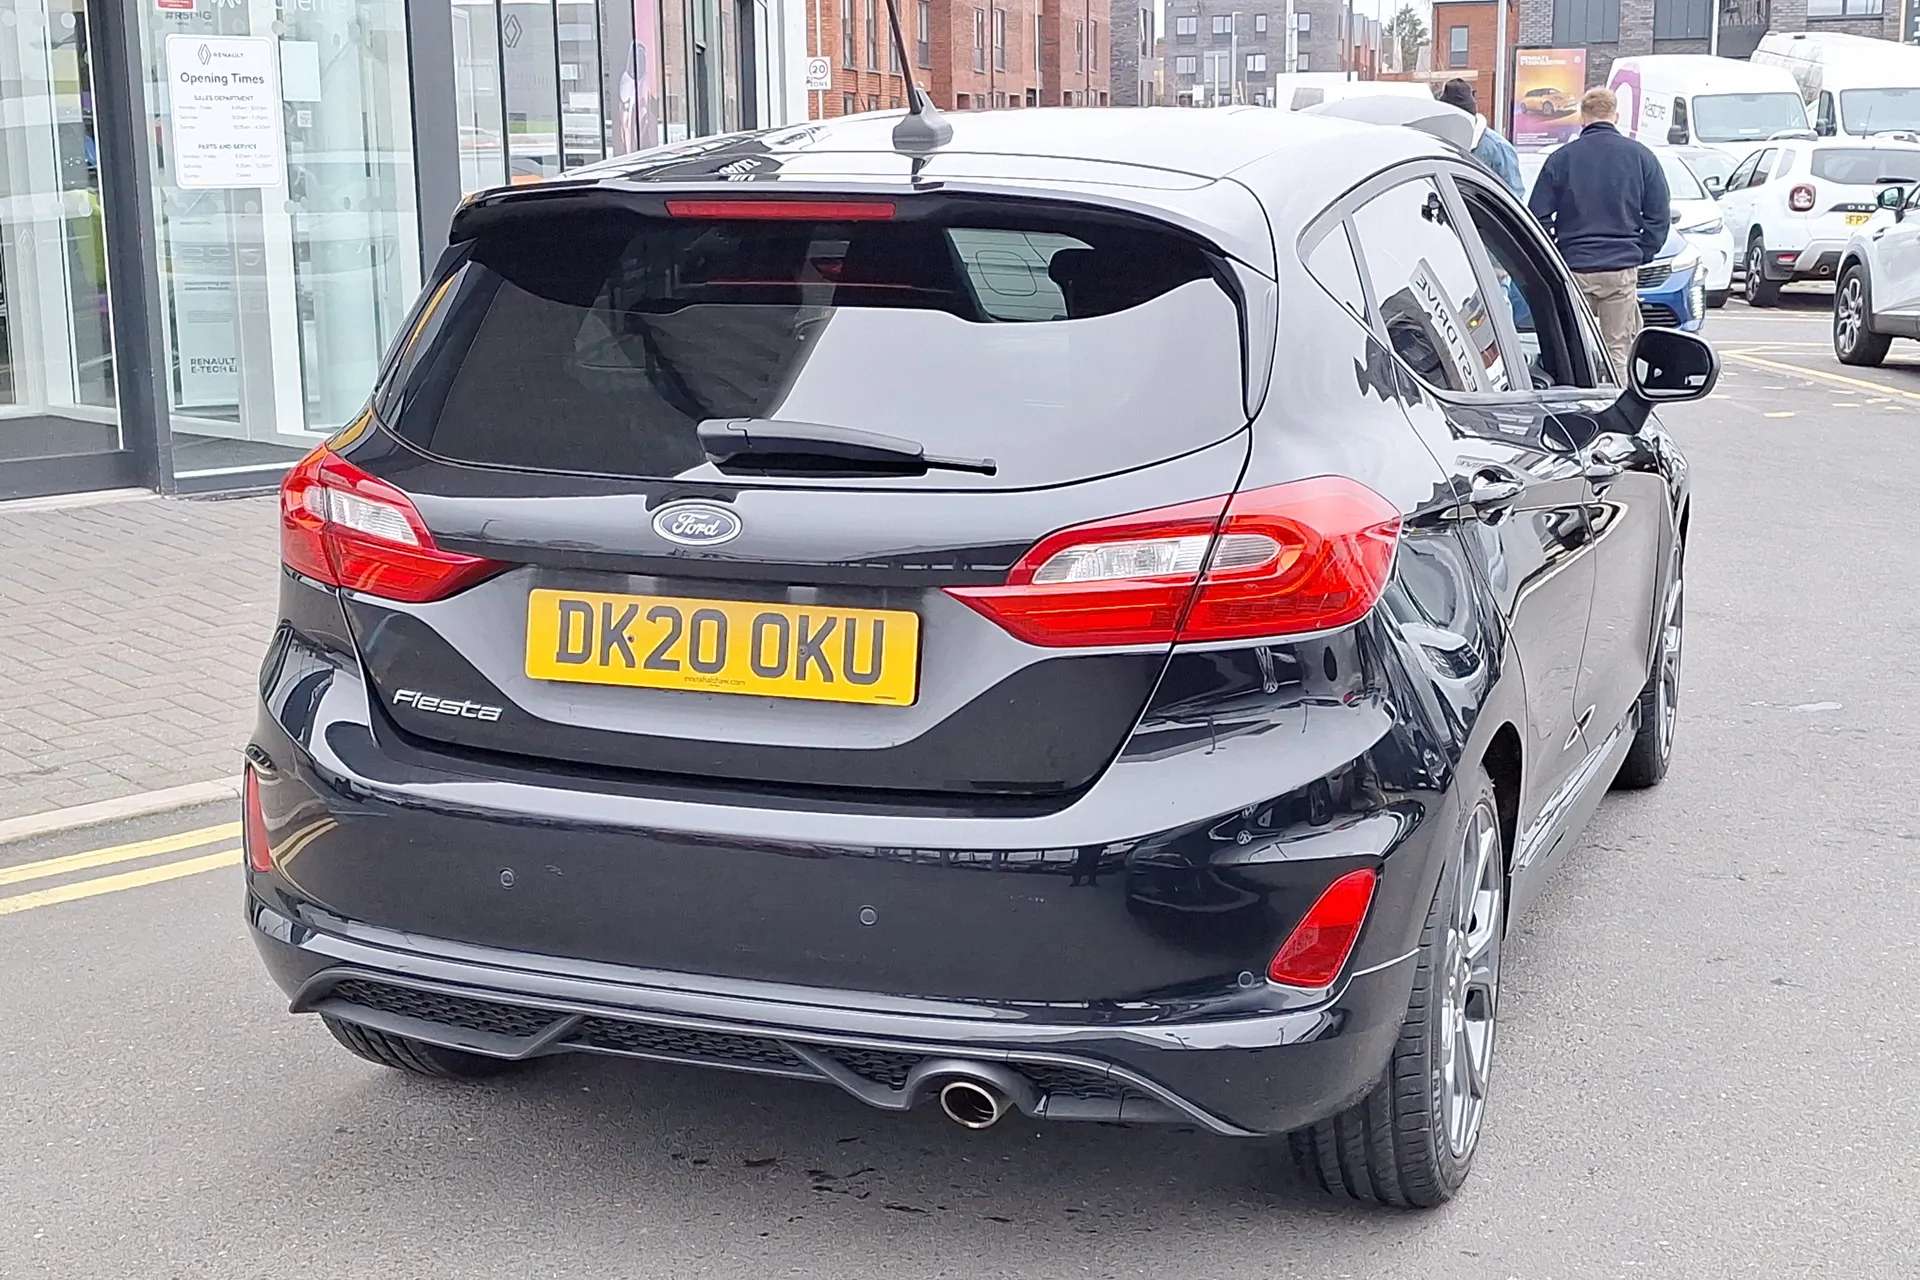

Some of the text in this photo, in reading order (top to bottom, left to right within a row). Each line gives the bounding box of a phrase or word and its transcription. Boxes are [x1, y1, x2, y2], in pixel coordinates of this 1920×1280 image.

[180, 72, 265, 86] Opening Times
[812, 65, 825, 74] 20
[190, 357, 236, 366] RENAULT
[671, 512, 721, 536] Ford
[555, 598, 885, 685] DK20 OKU
[392, 688, 503, 722] Fiesta
